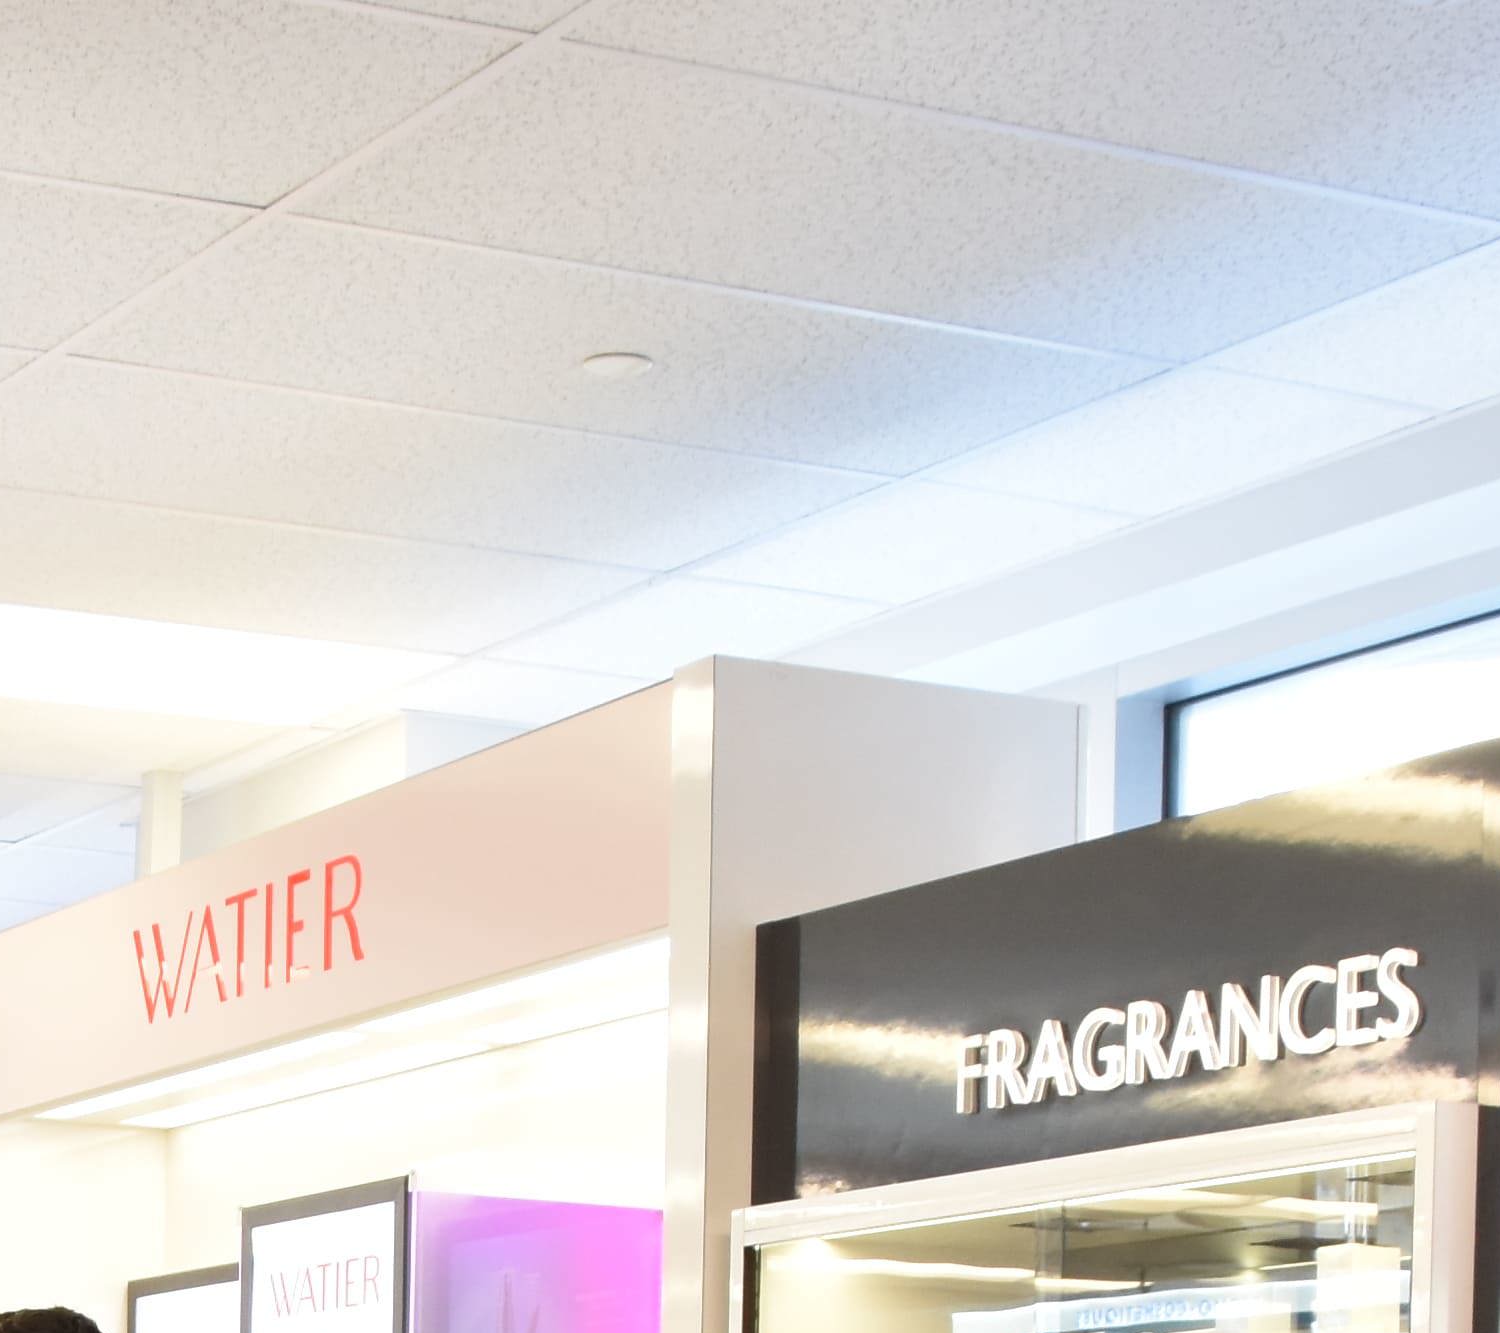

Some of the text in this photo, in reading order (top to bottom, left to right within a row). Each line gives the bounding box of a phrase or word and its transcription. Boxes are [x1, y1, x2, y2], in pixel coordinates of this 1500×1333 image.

[133, 856, 364, 1025] WATIER
[955, 947, 1422, 1114] FRAGRANCES
[270, 1255, 380, 1318] WATIER
